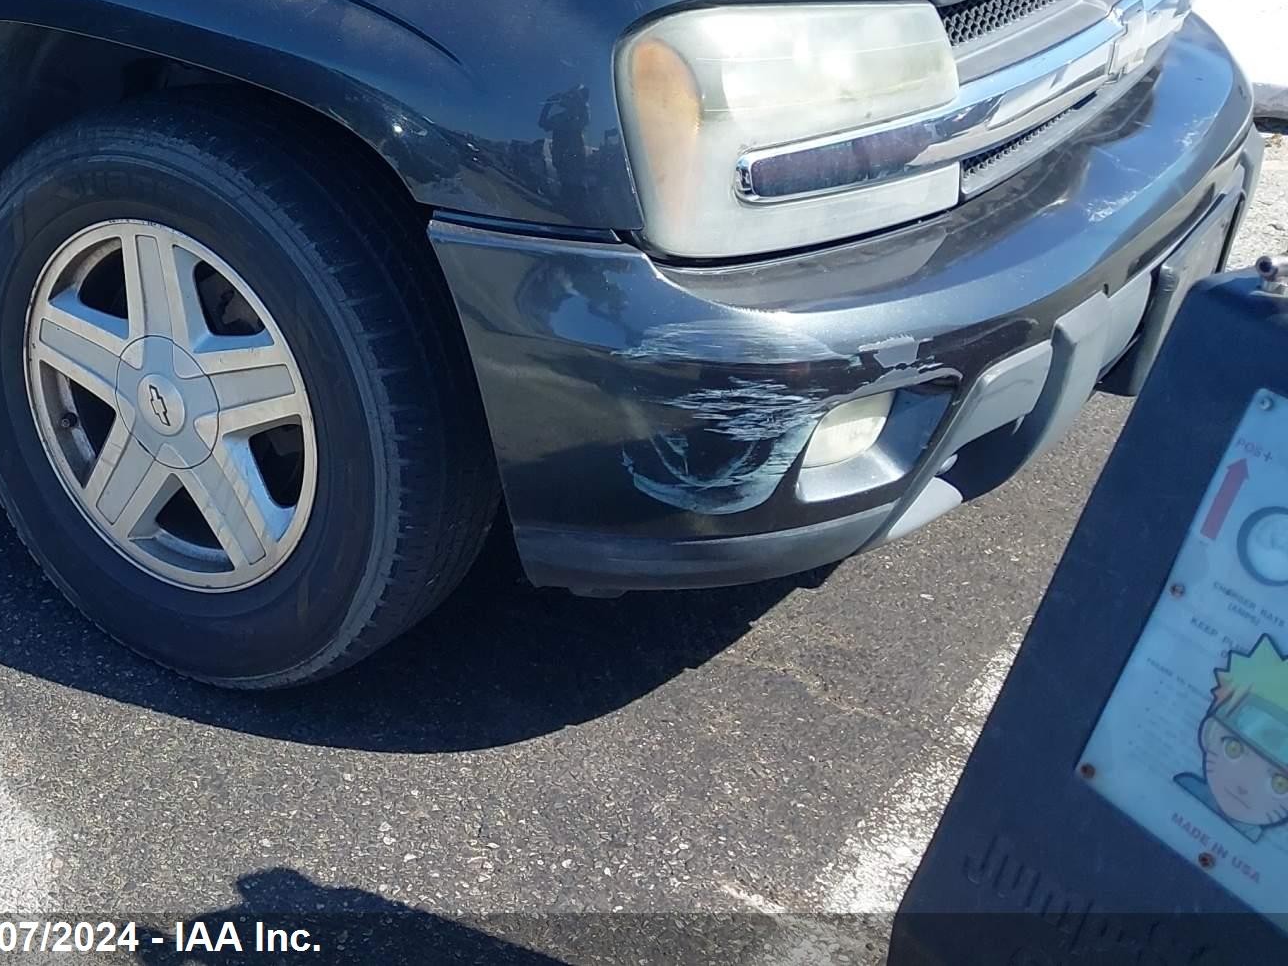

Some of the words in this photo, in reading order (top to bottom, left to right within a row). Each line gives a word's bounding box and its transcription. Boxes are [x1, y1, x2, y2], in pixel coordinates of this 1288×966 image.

[1170, 812, 1212, 847] MADE
[1211, 841, 1230, 859] IN
[1231, 856, 1261, 885] USA
